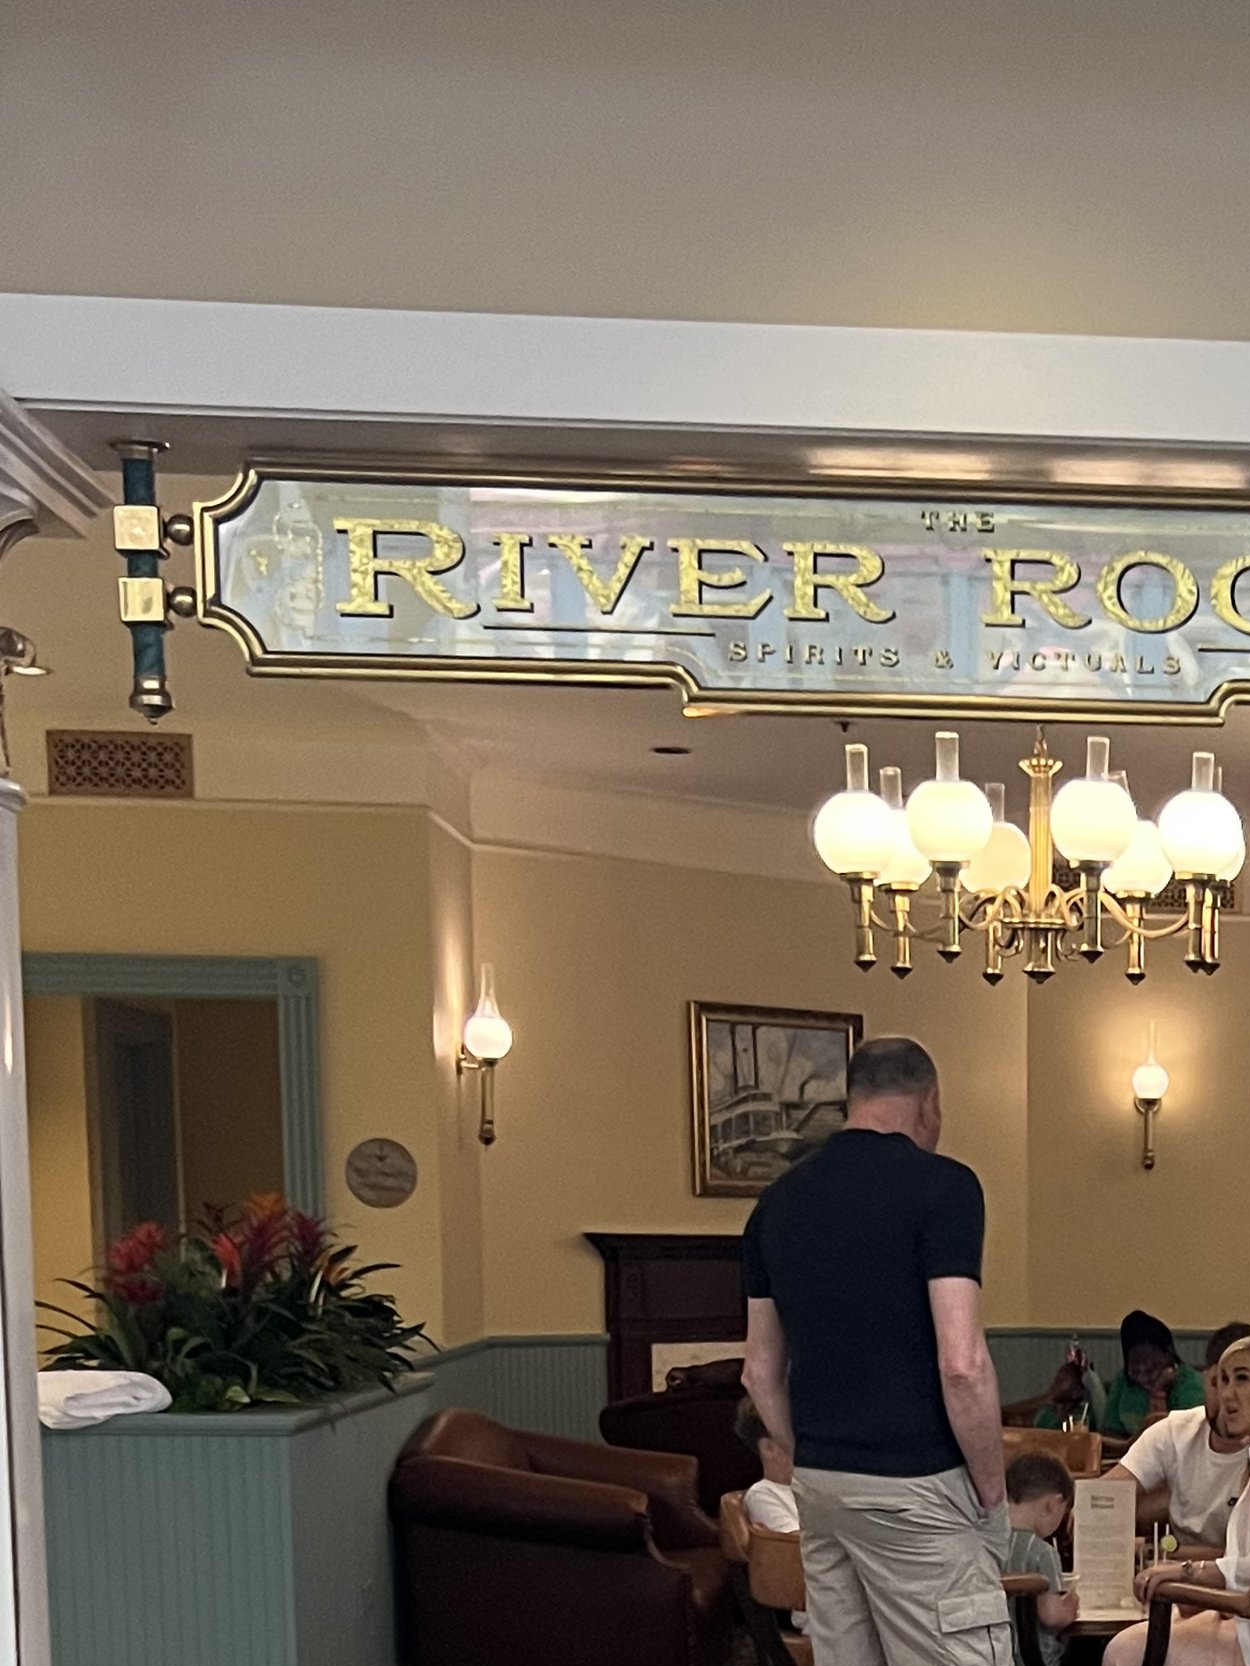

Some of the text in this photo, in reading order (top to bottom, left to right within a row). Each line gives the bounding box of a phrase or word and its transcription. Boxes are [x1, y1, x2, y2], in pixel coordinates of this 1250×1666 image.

[920, 510, 996, 533] THE
[333, 517, 897, 624] RIVER
[728, 640, 1183, 676] SPIRITS & VICTUALS
